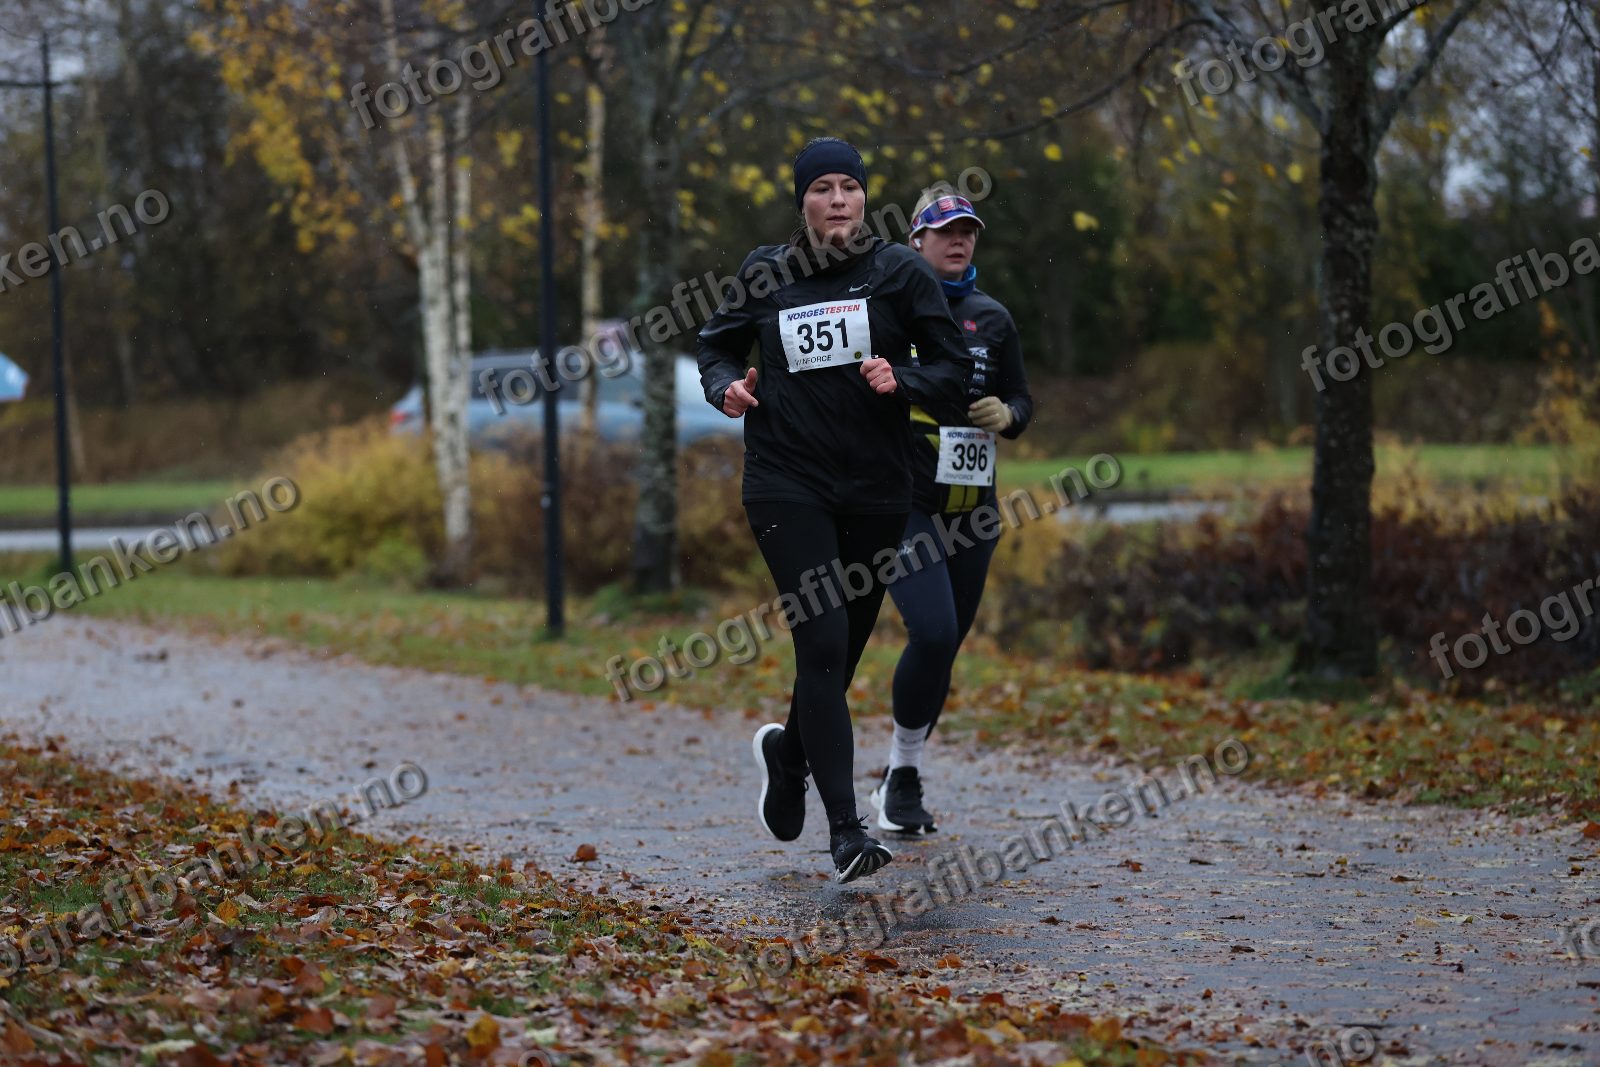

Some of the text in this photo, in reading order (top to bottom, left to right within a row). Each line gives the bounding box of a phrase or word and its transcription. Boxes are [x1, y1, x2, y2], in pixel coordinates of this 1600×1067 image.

[787, 304, 861, 321] NORGESTESTEN
[797, 317, 849, 354] 351
[952, 443, 988, 472] 396
